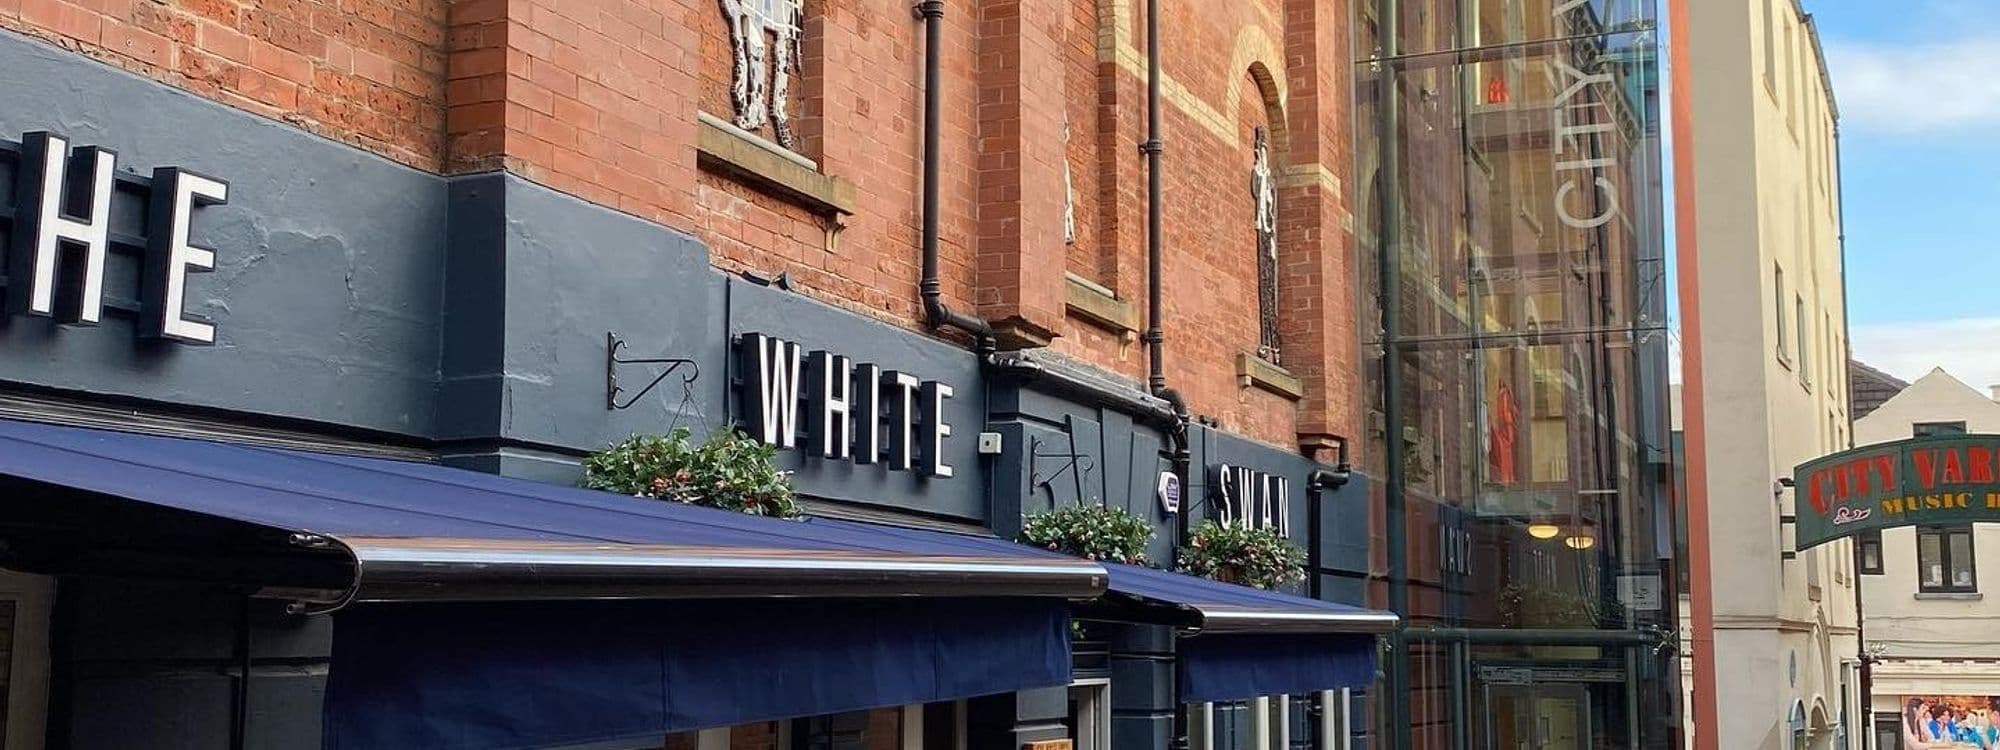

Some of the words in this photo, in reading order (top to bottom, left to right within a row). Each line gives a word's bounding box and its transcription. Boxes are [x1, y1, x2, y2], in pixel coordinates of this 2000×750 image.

[1553, 59, 1618, 228] CITY
[758, 334, 954, 477] WHITE
[1220, 463, 1290, 539] SWAN
[1809, 454, 1898, 516] CITY
[1912, 446, 2000, 489] VAR
[1880, 491, 1973, 515] MUSIC
